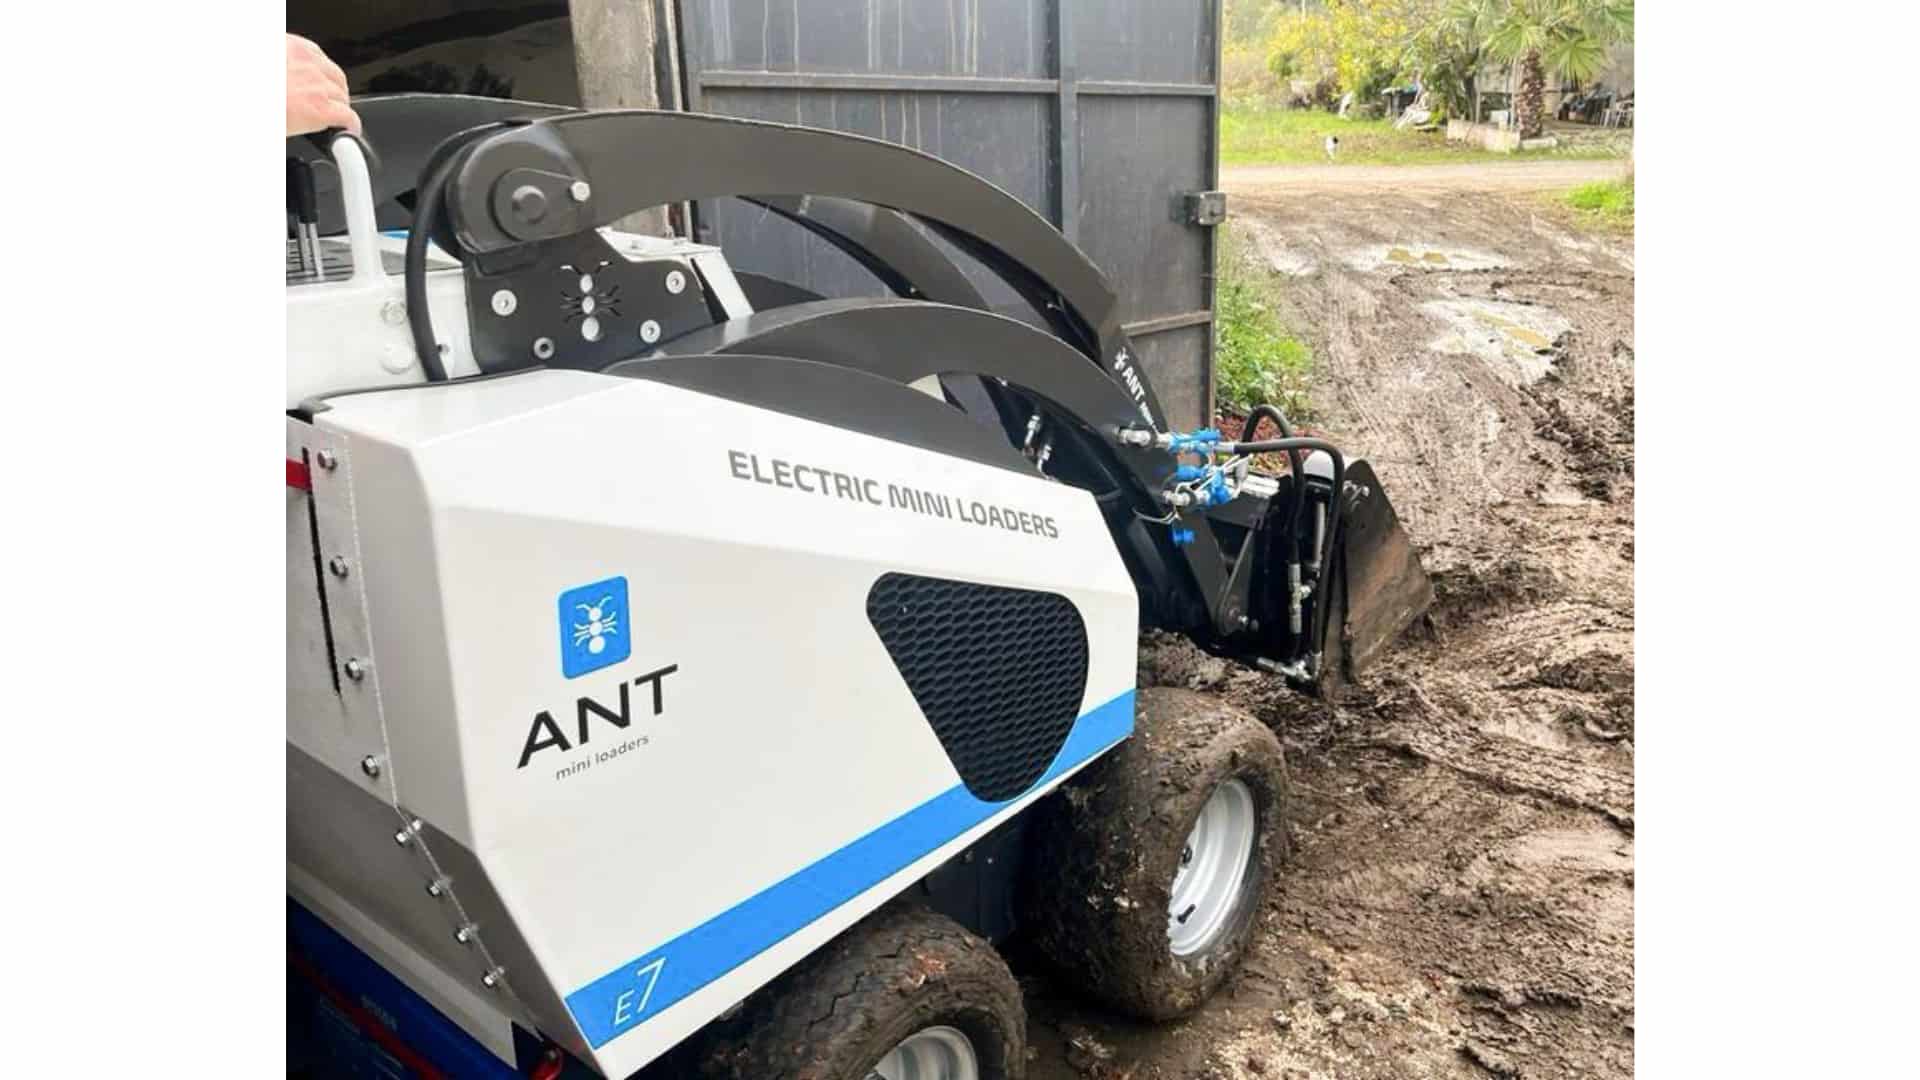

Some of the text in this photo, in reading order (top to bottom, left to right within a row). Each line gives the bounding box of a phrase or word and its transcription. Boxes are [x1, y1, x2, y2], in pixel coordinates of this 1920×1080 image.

[1121, 365, 1145, 401] ANT
[727, 449, 1059, 539] ELECTRIC MINI LOADERS
[516, 663, 678, 769] ANT
[554, 734, 650, 781] mini loaders
[614, 956, 666, 1025] E7
